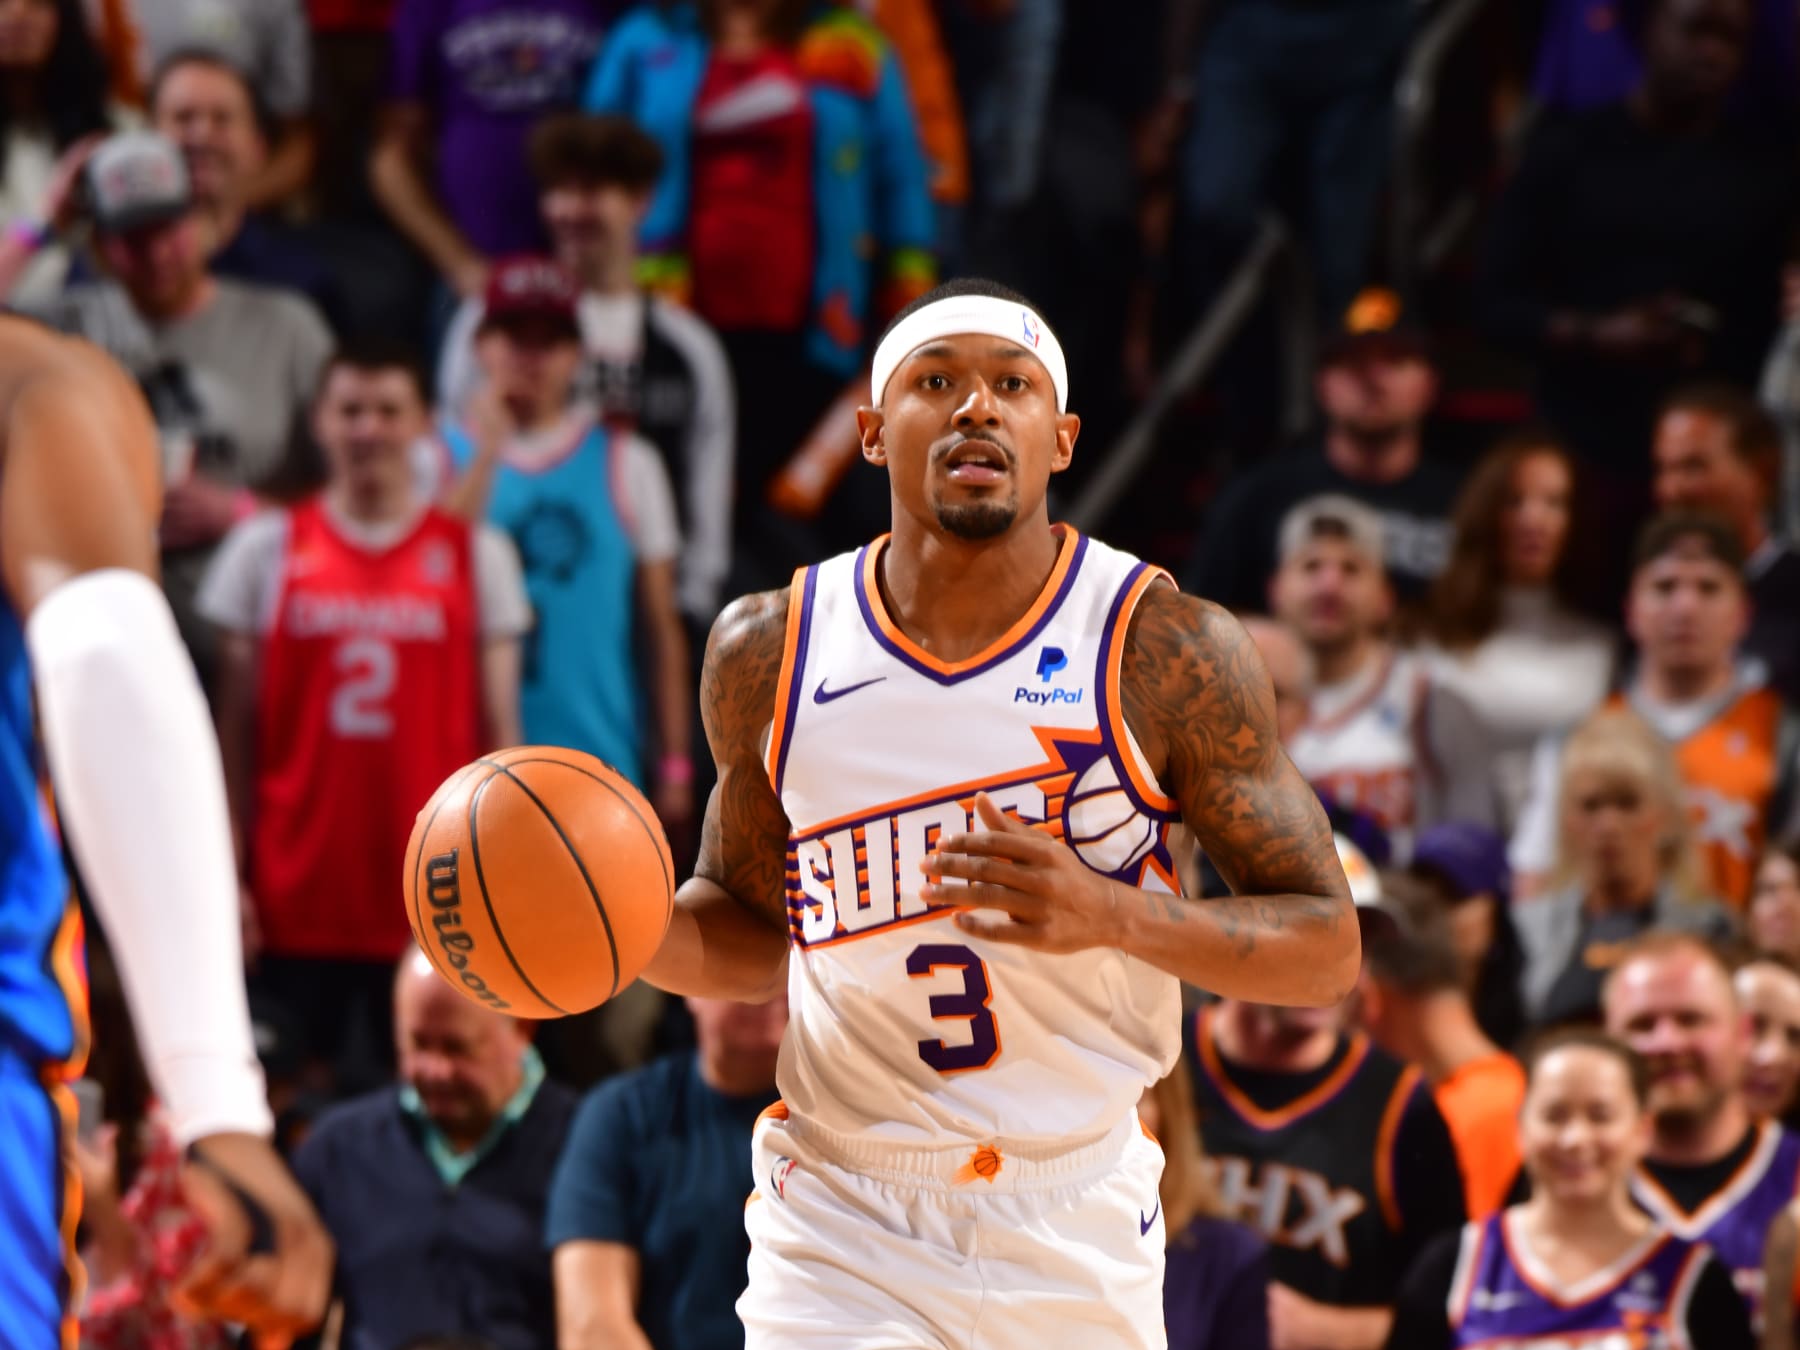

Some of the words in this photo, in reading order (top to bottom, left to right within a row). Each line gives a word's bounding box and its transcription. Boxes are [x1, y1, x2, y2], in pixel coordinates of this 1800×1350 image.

[331, 640, 398, 738] 2
[1014, 687, 1084, 706] PayPal
[425, 847, 512, 1009] Wilson
[906, 943, 1003, 1075] 3
[1202, 1156, 1366, 1269] HX
